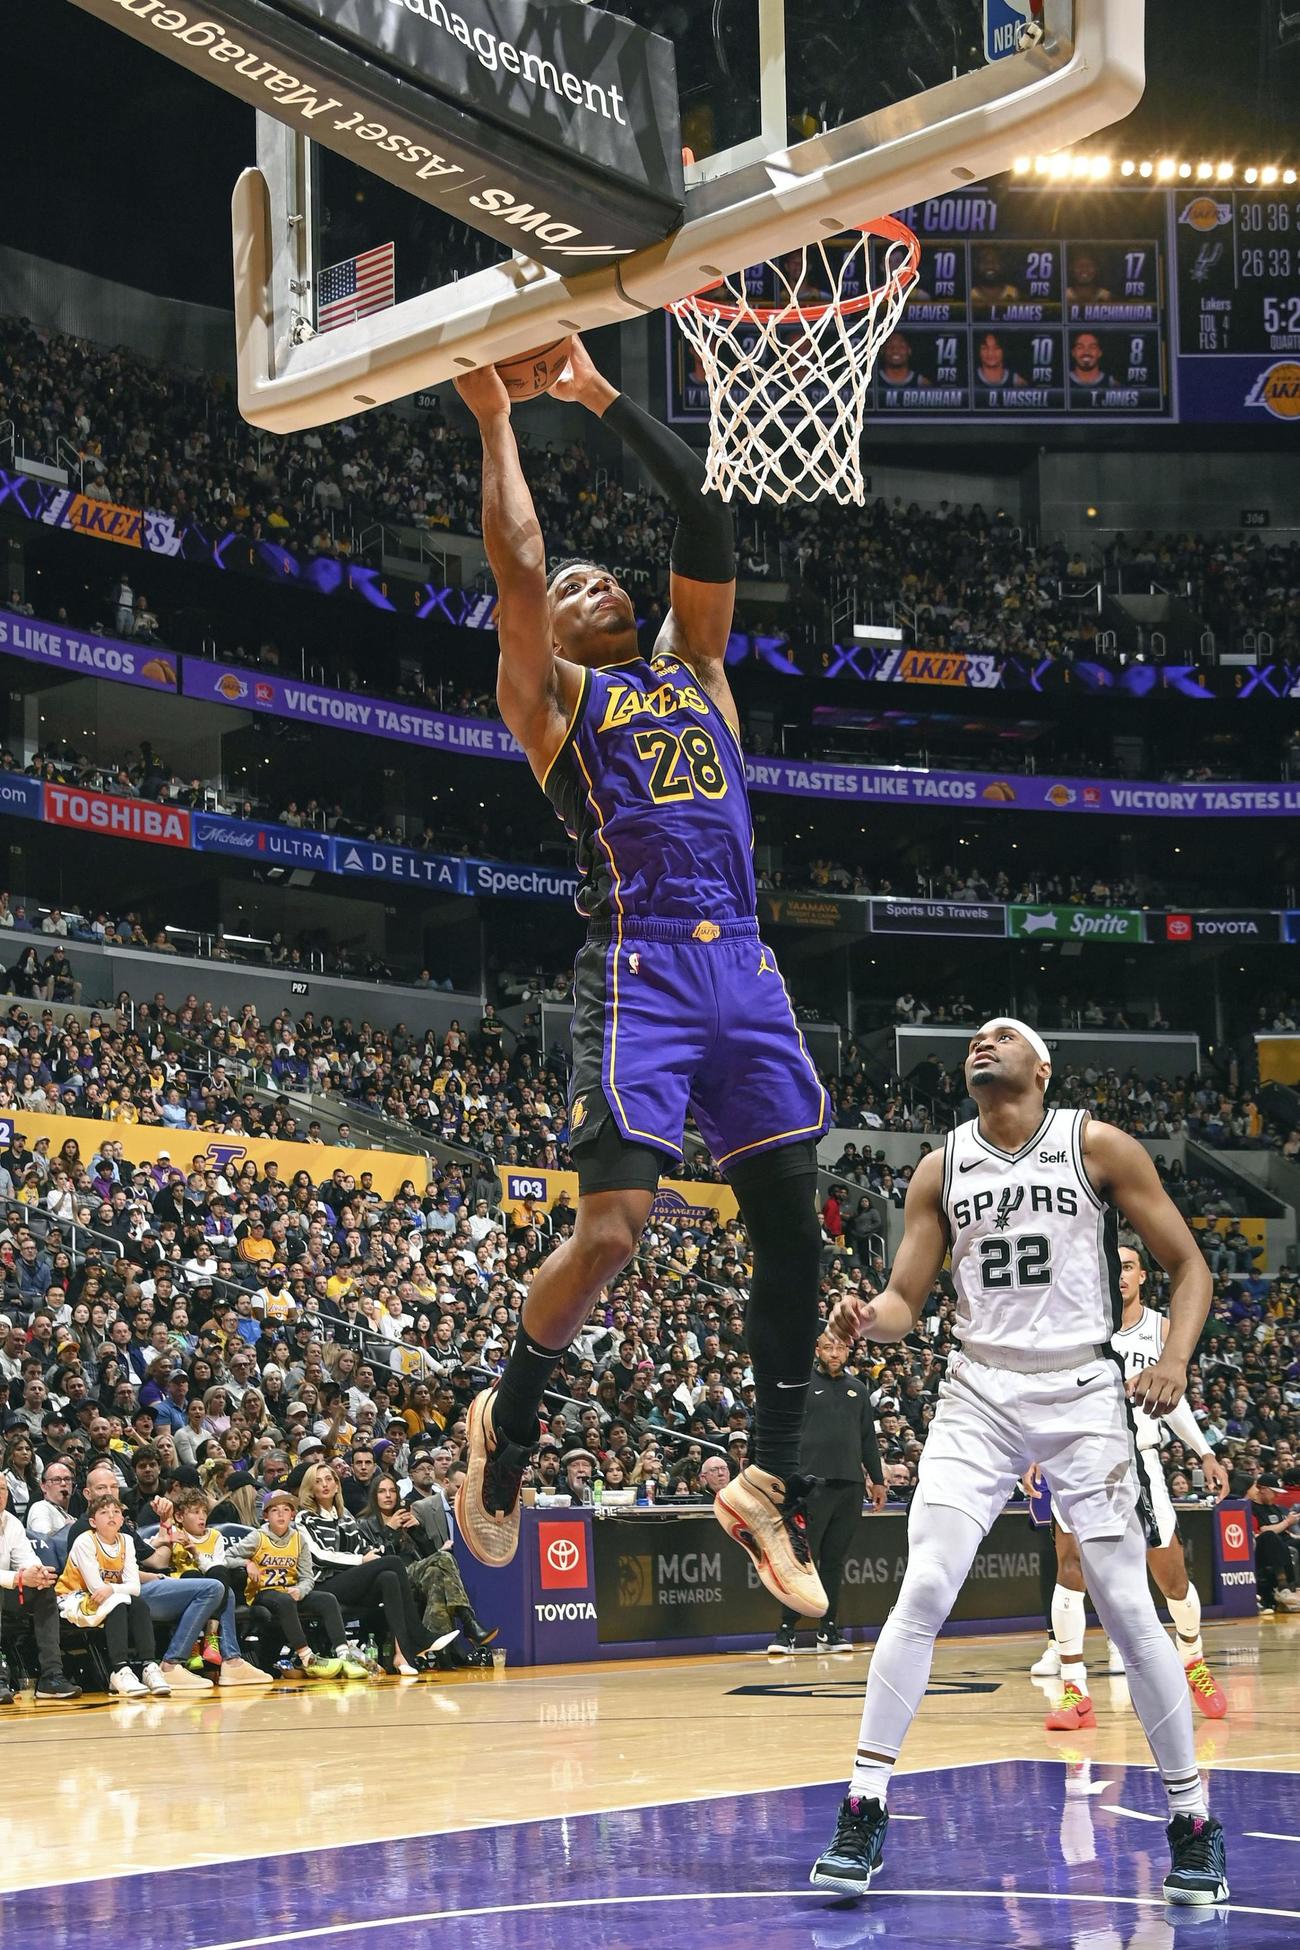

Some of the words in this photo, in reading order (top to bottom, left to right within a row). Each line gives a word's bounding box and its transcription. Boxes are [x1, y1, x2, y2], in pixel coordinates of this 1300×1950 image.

[391, 0, 626, 125] anagement
[333, 112, 465, 180] Asset
[469, 188, 583, 244] DWS
[923, 199, 997, 232] COURT
[1241, 204, 1262, 231] 30
[1268, 204, 1289, 231] 36
[934, 252, 956, 279] 10
[1026, 252, 1053, 280] 26
[1125, 253, 1145, 279] 17
[1242, 250, 1263, 277] 26
[1269, 250, 1290, 277] 33
[935, 282, 955, 295] PTS
[1030, 282, 1049, 296] PTS
[1125, 282, 1145, 296] PTS
[908, 306, 950, 321] REAVES
[1003, 306, 1043, 321] JAMES
[1084, 305, 1153, 321] HACHIMURA
[935, 338, 957, 364] 14
[1032, 338, 1053, 364] 10
[1131, 338, 1144, 365] 8
[937, 367, 957, 381] PTS
[1032, 367, 1052, 381] PTS
[1128, 367, 1147, 382] PTS
[903, 391, 962, 406] BRANHAM
[1003, 391, 1049, 406] VASSELL
[1102, 391, 1139, 406] JONES
[13, 625, 62, 658] LIKE
[66, 639, 135, 675] TACOS
[283, 688, 372, 725] VICTORY
[375, 709, 445, 741] TASTES
[448, 724, 494, 749] LIKE
[597, 682, 710, 734] LAKERS
[633, 726, 728, 805] 28
[0, 787, 26, 804] om
[785, 770, 858, 793] TASTES
[863, 776, 909, 796] LIKE
[912, 779, 976, 800] TACOS
[1110, 789, 1199, 810] VICTORY
[1202, 792, 1281, 810] TASTES
[50, 791, 184, 841] TOSHIBA
[198, 824, 255, 848] Michelob
[270, 836, 326, 861] ULTRA
[372, 852, 453, 884] DELTA
[478, 866, 578, 896] Spectrum
[886, 904, 924, 917] Sports
[927, 906, 945, 917] US
[948, 907, 989, 919] Travels
[1070, 913, 1129, 937] Sprite
[1196, 921, 1259, 935] TOYOTA
[292, 982, 307, 994] PR7
[1039, 1150, 1068, 1164] Self.
[512, 1179, 543, 1198] 103
[654, 1206, 669, 1214] LOS
[669, 1207, 706, 1217] ANGELES
[953, 1185, 1078, 1231] SPURS
[979, 1233, 1053, 1291] 22
[259, 1553, 297, 1567] LAKERS
[658, 1553, 722, 1585] MGM
[265, 1568, 289, 1587] 23
[1221, 1571, 1256, 1586] TOYOTA
[659, 1587, 722, 1605] REWARDS
[535, 1602, 597, 1622] TOYOTA
